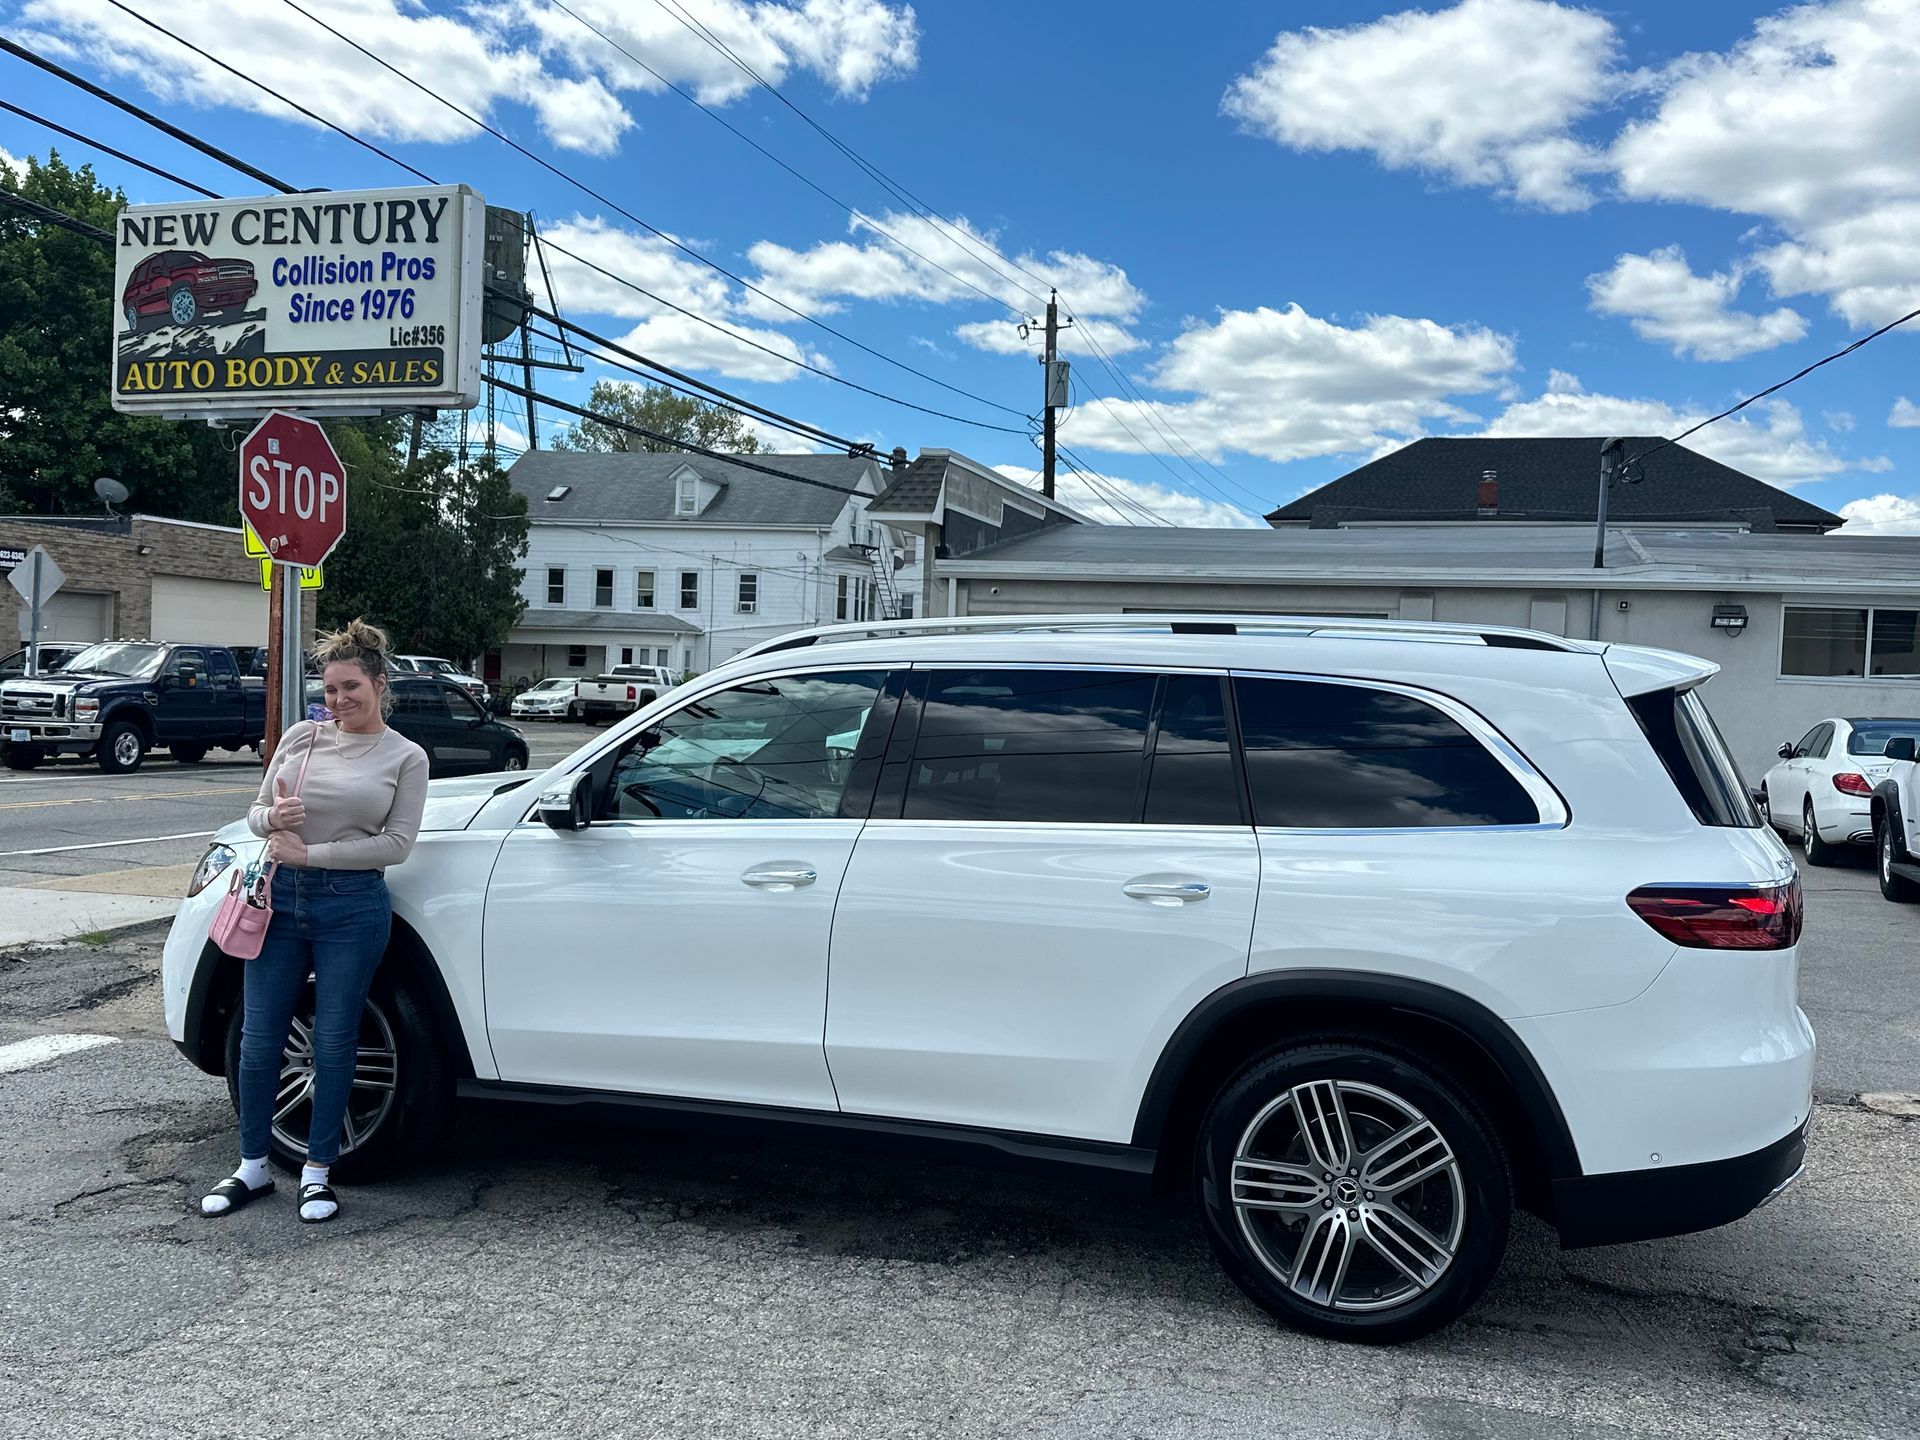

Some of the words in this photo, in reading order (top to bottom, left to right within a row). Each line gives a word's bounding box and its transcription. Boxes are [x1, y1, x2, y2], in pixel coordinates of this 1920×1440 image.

[121, 213, 219, 246] NEW
[231, 198, 448, 245] CENTURY
[273, 255, 374, 288] Collision
[381, 251, 436, 282] Pros
[288, 292, 354, 324] Since
[360, 287, 415, 321] 1976
[390, 325, 445, 347] Lic#356
[123, 360, 215, 390] AUTO
[225, 357, 321, 388] BODY
[324, 362, 345, 385] &
[352, 359, 439, 385] SALES
[249, 455, 339, 523] STOP
